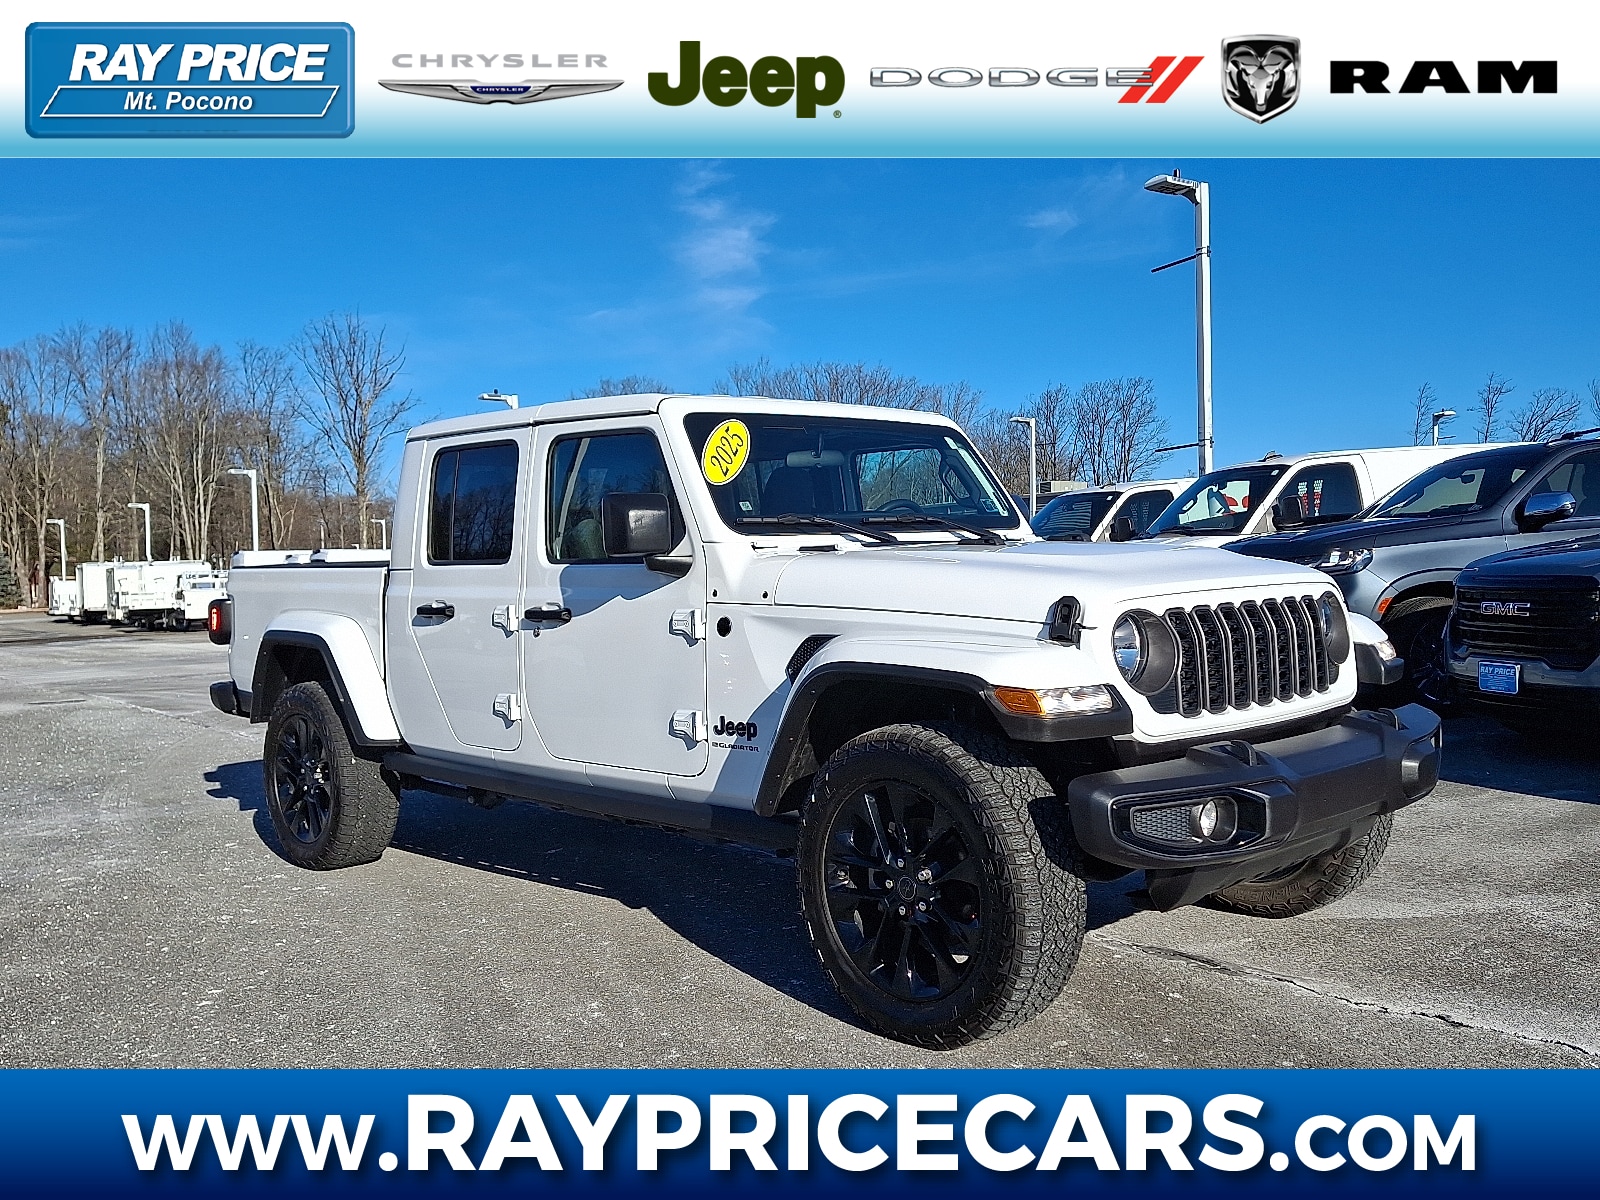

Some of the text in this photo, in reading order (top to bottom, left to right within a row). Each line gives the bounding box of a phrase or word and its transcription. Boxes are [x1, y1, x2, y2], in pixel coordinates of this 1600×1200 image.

[710, 425, 744, 477] 2025
[1481, 601, 1530, 616] GMC
[1494, 667, 1515, 676] PRICE
[713, 715, 758, 741] Jeep
[719, 743, 759, 752] GLADIATOR
